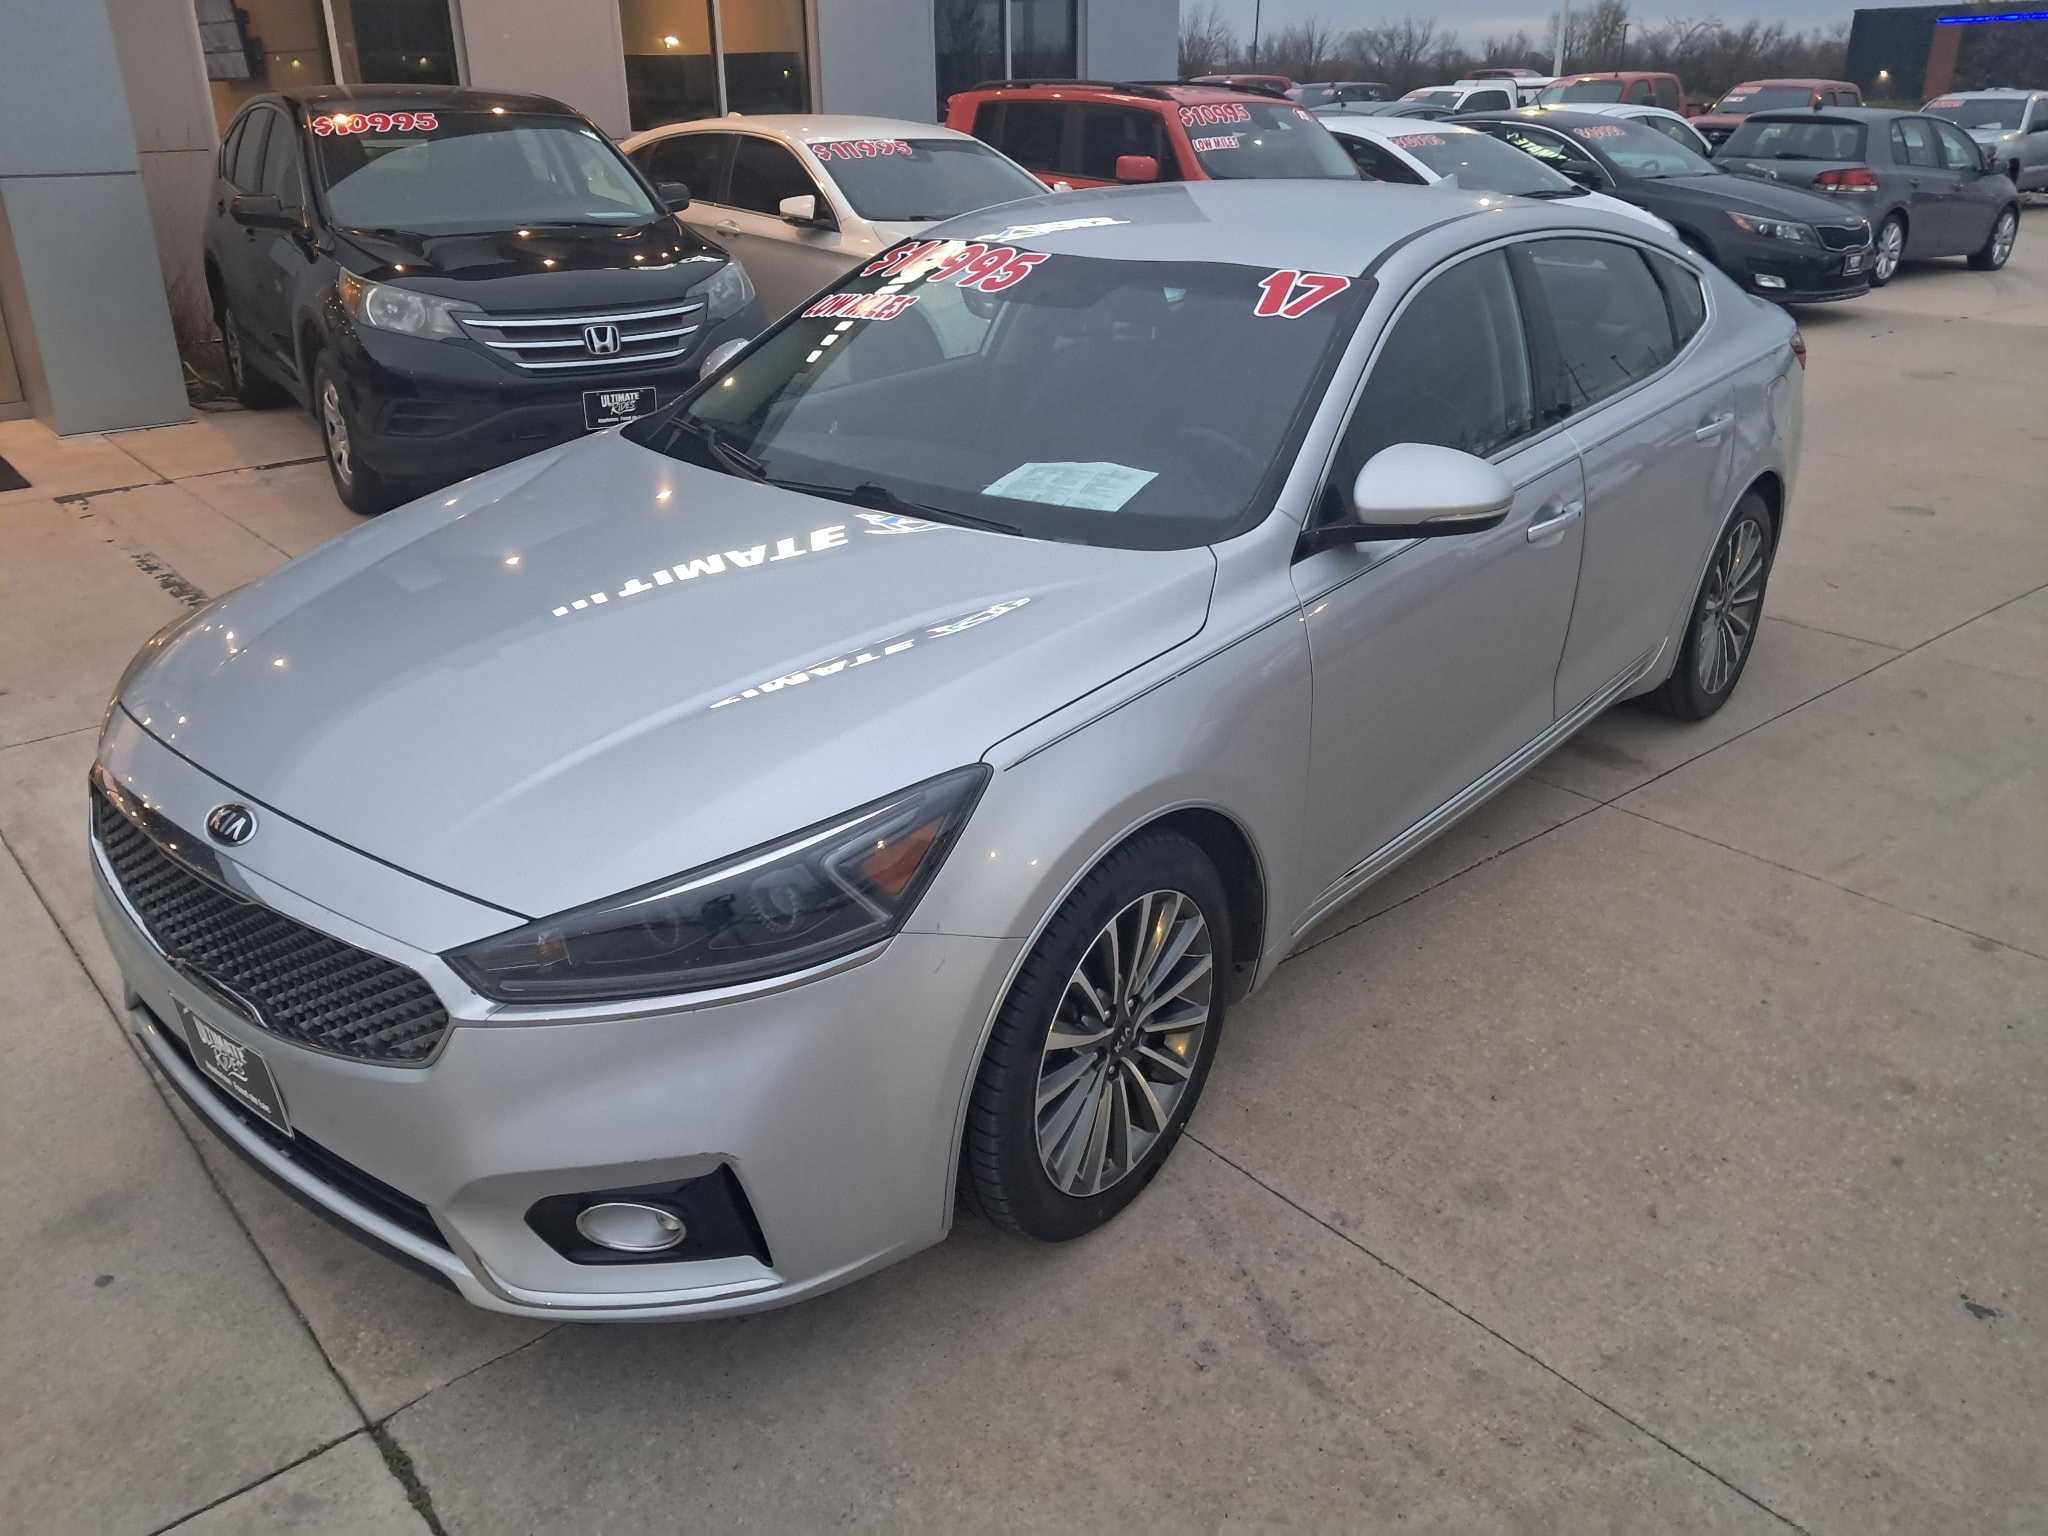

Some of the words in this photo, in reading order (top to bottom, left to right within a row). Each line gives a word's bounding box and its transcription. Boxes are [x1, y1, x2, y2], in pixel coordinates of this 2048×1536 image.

[312, 112, 439, 136] $10995
[1179, 103, 1251, 127] $10995
[812, 141, 912, 161] $11995
[1192, 138, 1213, 152] LOW
[1212, 136, 1239, 150] MILES
[860, 240, 1052, 292] $1995
[801, 294, 862, 317] LOW
[1254, 270, 1350, 319] 17
[600, 392, 640, 407] ULTIMATE
[209, 807, 247, 841] KIA
[193, 1016, 247, 1064] ULTIMATE
[1114, 1027, 1131, 1053] KIA
